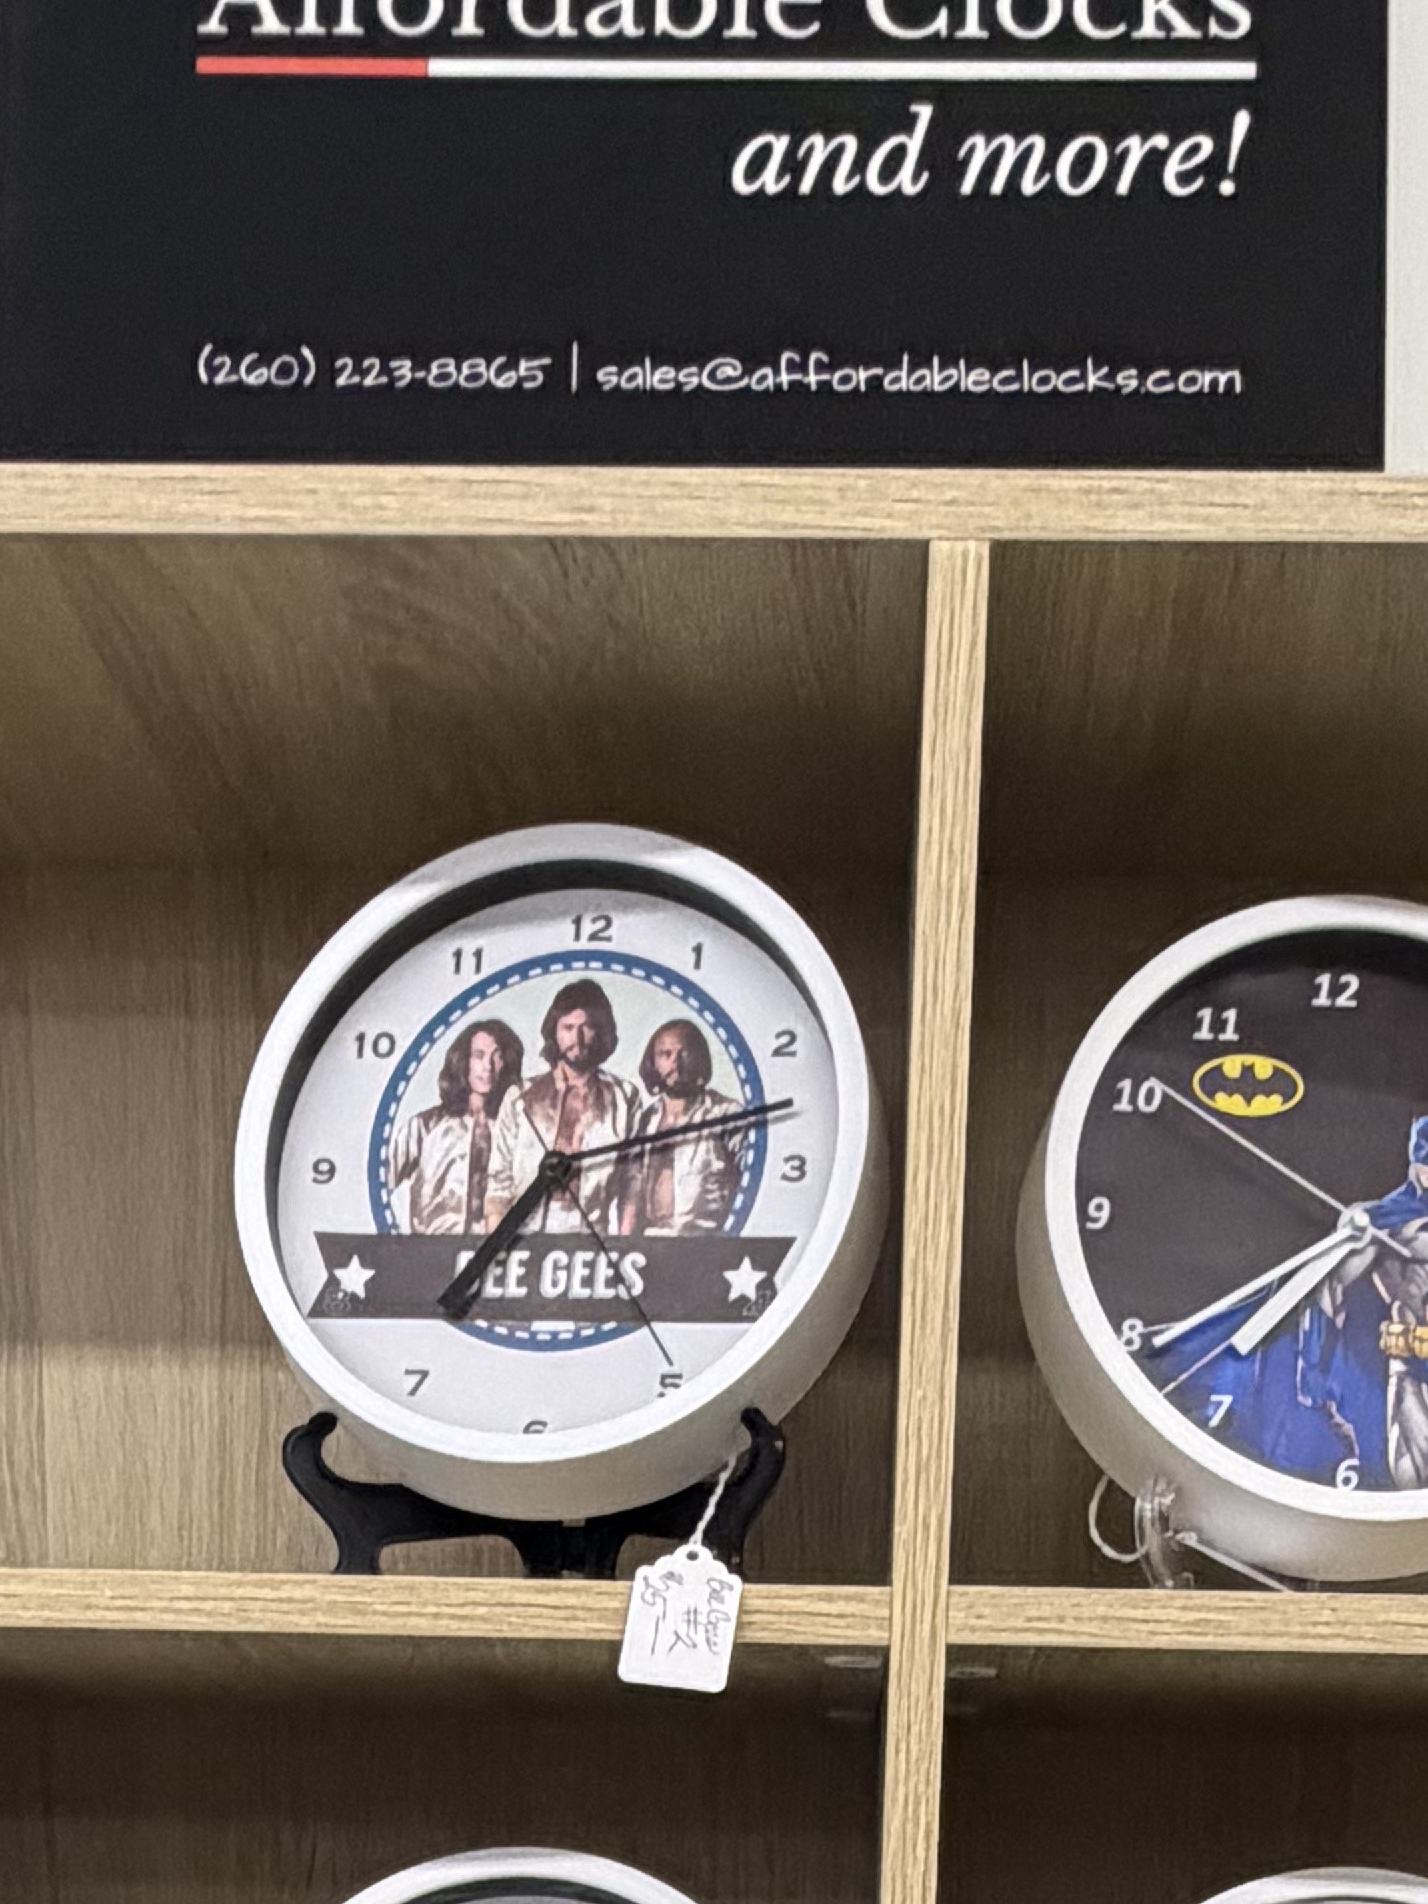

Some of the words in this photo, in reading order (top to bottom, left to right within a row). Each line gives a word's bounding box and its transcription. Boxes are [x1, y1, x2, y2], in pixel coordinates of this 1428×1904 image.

[730, 104, 932, 197] and
[956, 108, 1254, 197] more!
[197, 343, 316, 387] (260)
[334, 357, 552, 389] 223-8865
[595, 354, 1243, 397] sales@affordableclocks.com
[570, 915, 614, 943] 12
[452, 947, 485, 975] 11
[691, 943, 704, 969] 1
[1311, 974, 1359, 1007] 12
[1193, 1008, 1240, 1040] 11
[354, 1032, 396, 1059] 10
[772, 1031, 798, 1057] 2
[1113, 1079, 1162, 1113] 10
[311, 1158, 336, 1185] 9
[780, 1155, 808, 1181] 3
[1086, 1197, 1110, 1229] 9
[539, 1250, 647, 1299] GEES
[403, 1368, 430, 1397] 7
